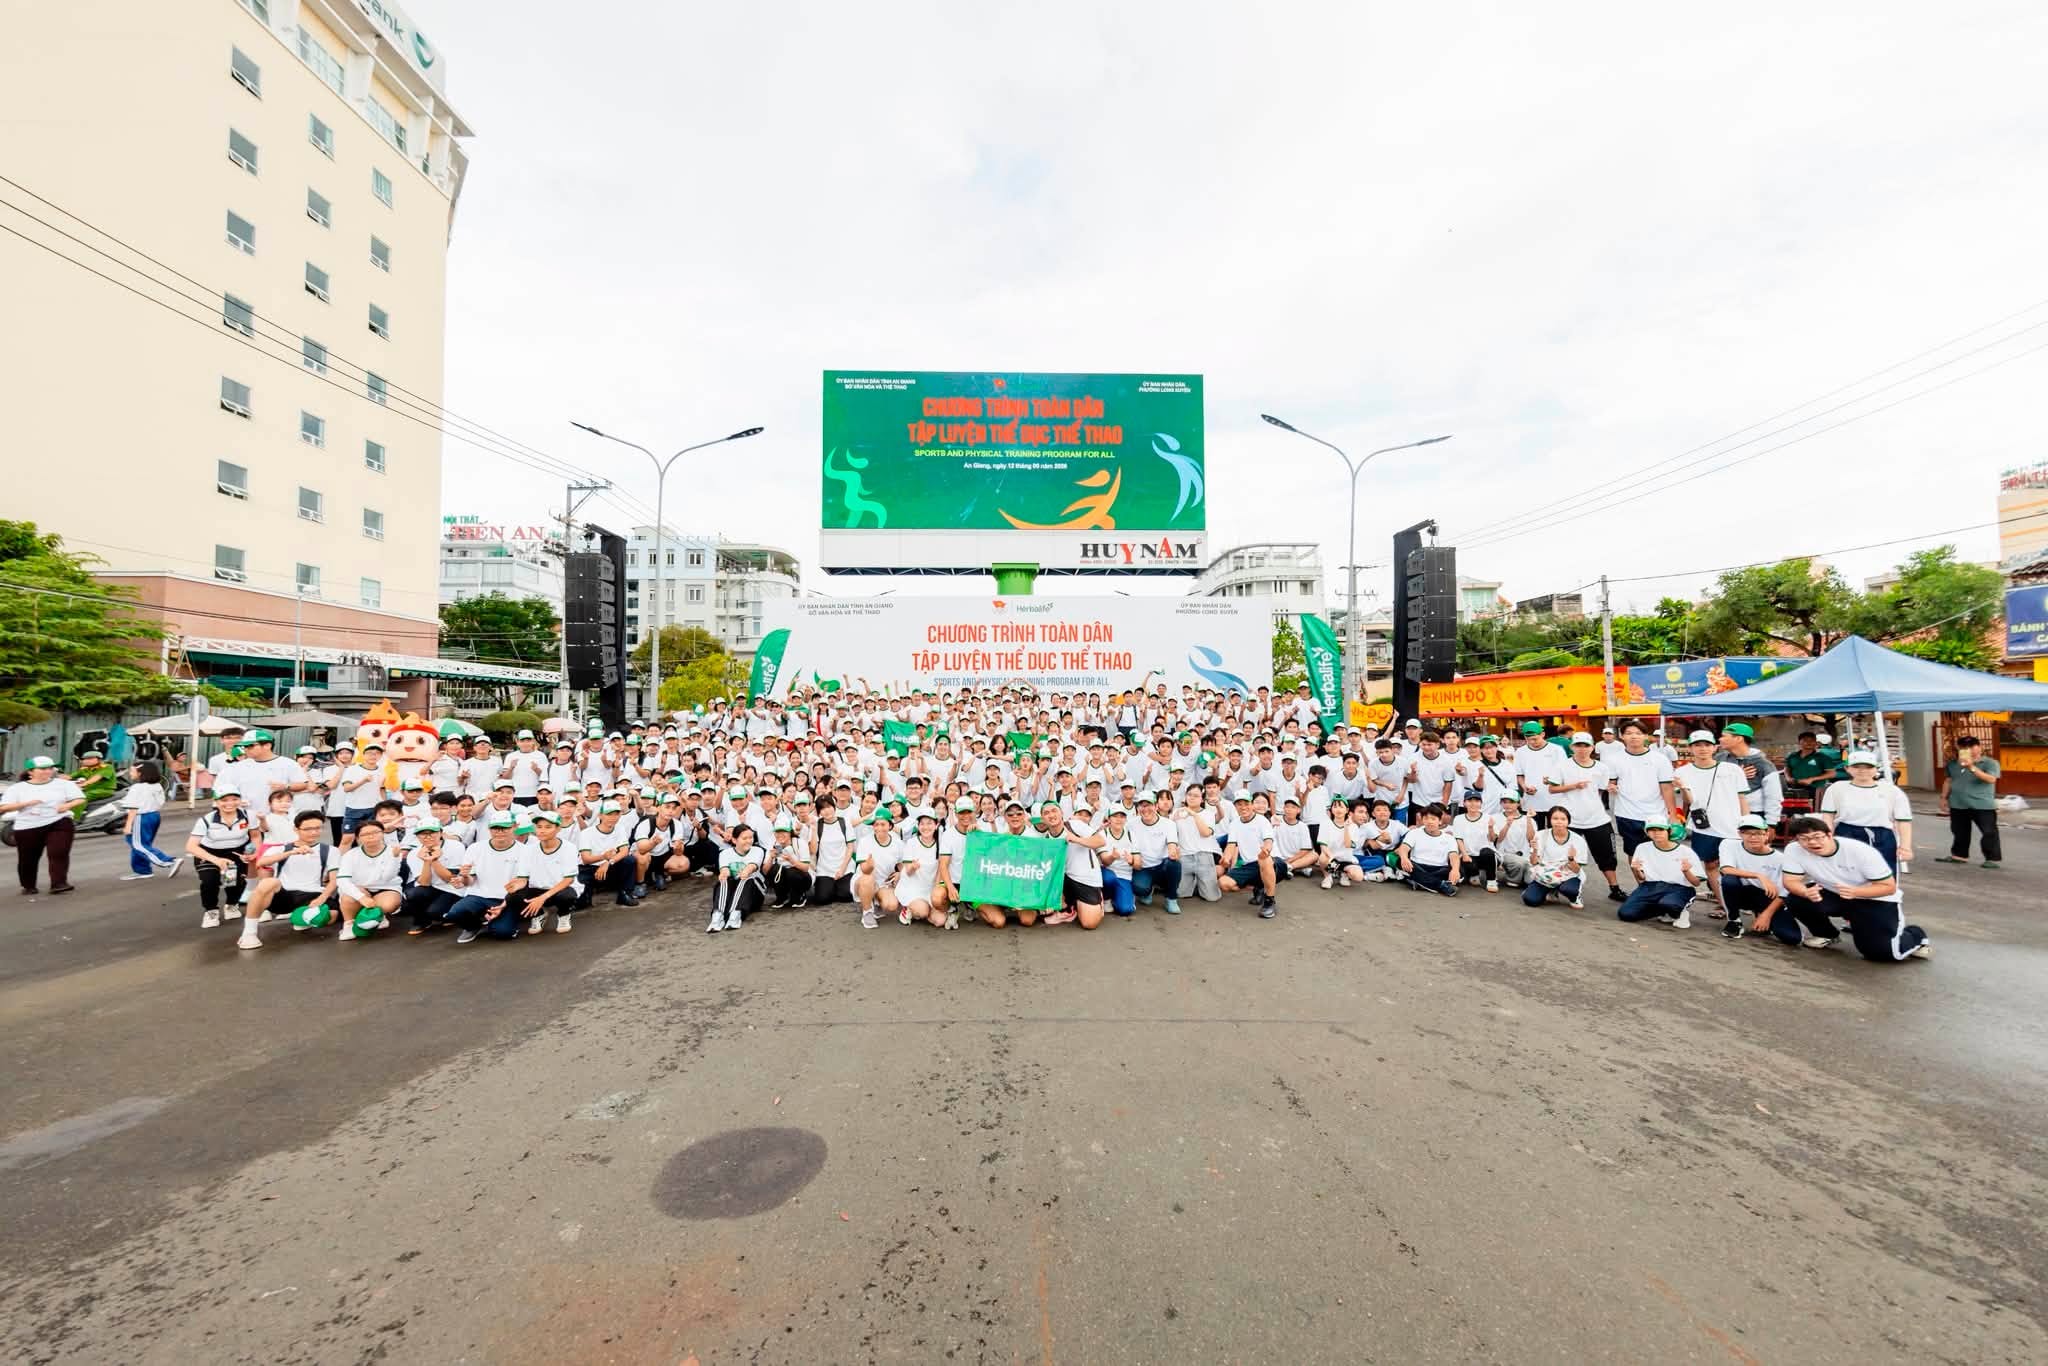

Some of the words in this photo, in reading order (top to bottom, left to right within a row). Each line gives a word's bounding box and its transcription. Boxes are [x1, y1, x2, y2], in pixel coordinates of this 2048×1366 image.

[1085, 425, 1123, 444] THAO
[914, 449, 946, 458] SPORTS
[946, 449, 964, 458] AND
[965, 449, 1003, 458] PHYSICAL
[1004, 449, 1040, 458] TRAINING
[1042, 449, 1081, 458] PROGRAM
[1083, 449, 1099, 458] FOR
[1100, 449, 1115, 458] ALL
[511, 525, 545, 540] AN
[1080, 543, 1136, 564] HUY
[1140, 536, 1198, 558] NAM
[928, 623, 987, 643] CHƯƠNG
[992, 621, 1035, 643] TRÌNH
[1040, 621, 1078, 643] TOÀN
[1083, 621, 1112, 643] DÂN
[912, 650, 940, 674] TẬP
[944, 650, 991, 674] LUYỆN
[995, 645, 1025, 671] THỂ
[1028, 652, 1057, 674] DỤC
[1061, 645, 1091, 671] THỂ
[1094, 652, 1132, 671] THAO
[962, 677, 976, 686] AND
[1046, 677, 1080, 687] PROGRAM
[1082, 677, 1095, 687] FOR
[1097, 677, 1110, 687] ALL
[1318, 651, 1337, 717] Herbalife
[1432, 689, 1462, 705] KINH
[979, 858, 1045, 881] Herbalife
